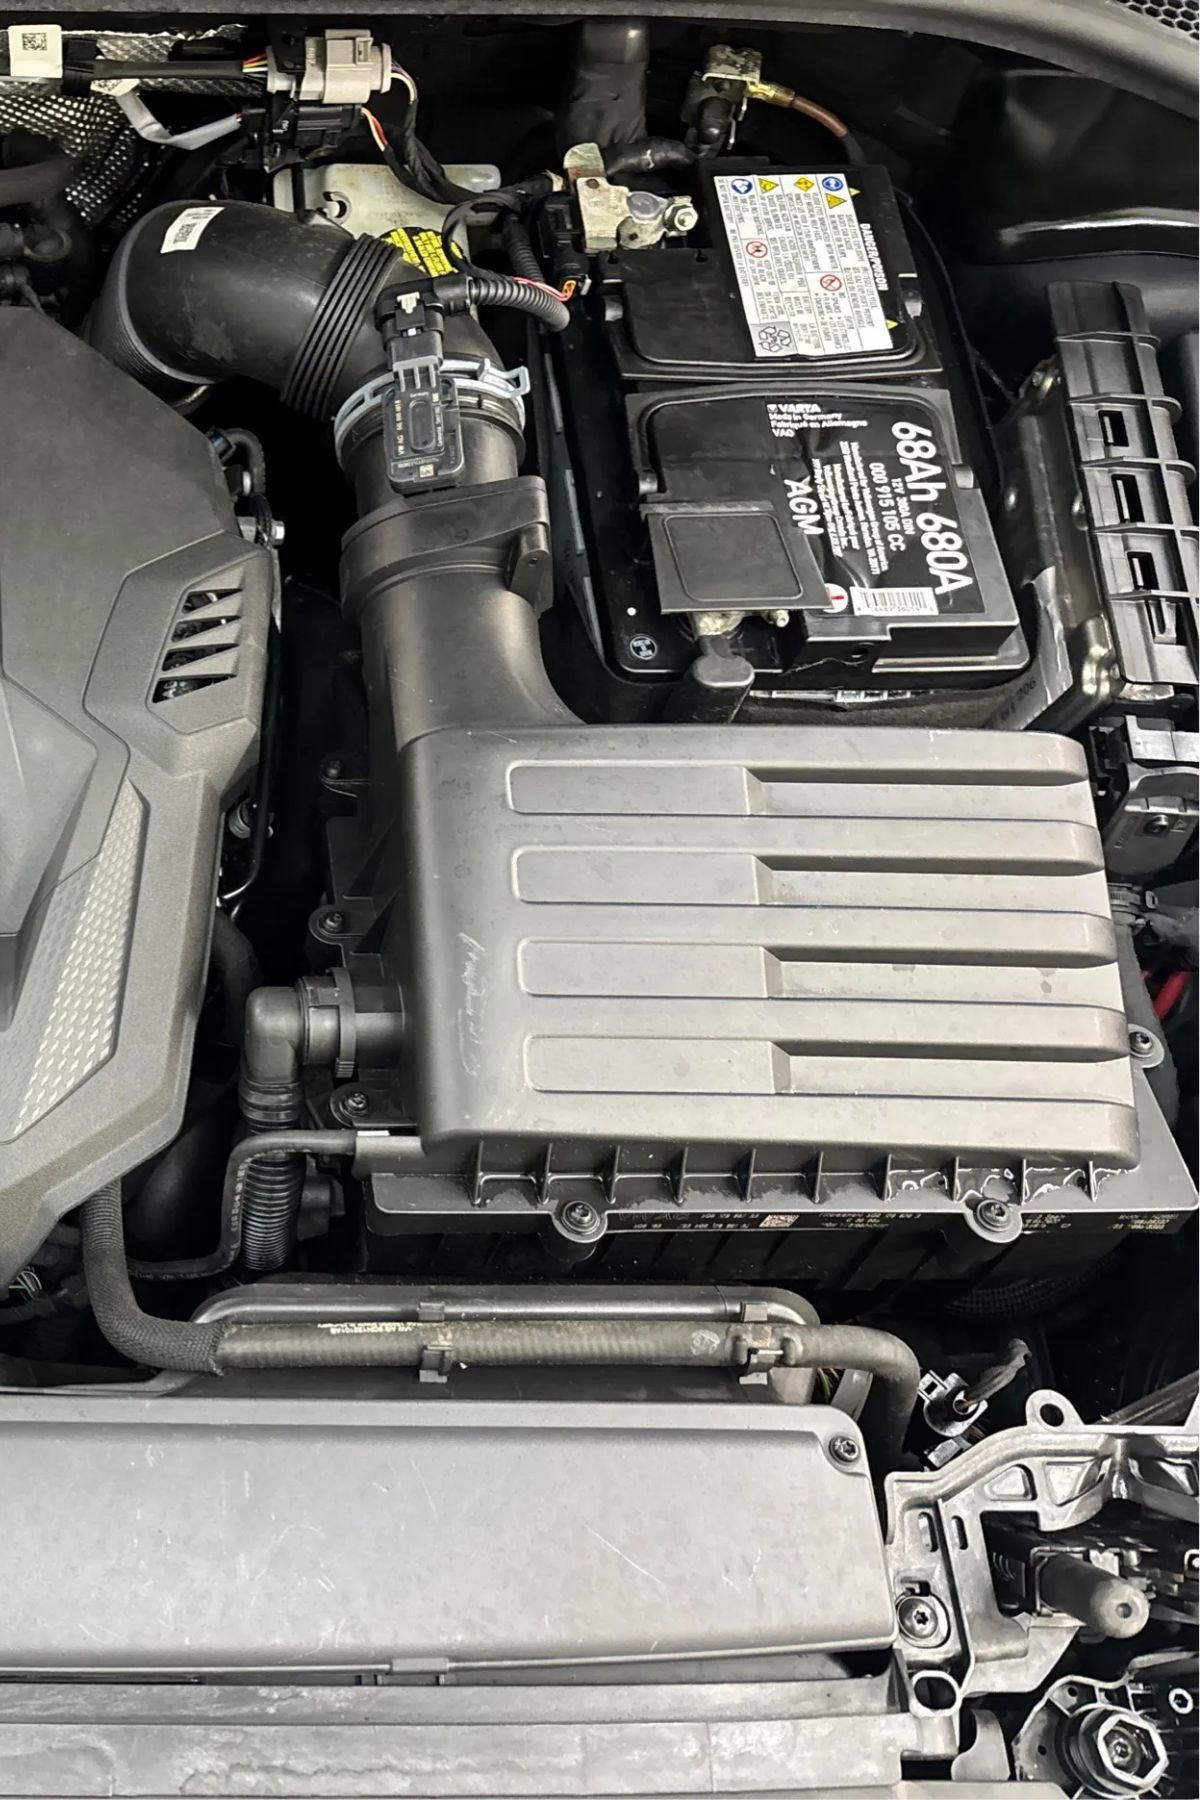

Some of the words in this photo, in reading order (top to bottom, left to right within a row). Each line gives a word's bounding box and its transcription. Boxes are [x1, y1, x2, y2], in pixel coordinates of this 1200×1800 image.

[860, 223, 888, 291] DANGER/POISON
[778, 403, 821, 413] VARTA
[802, 412, 842, 421] Germany
[821, 420, 868, 429] Allemagne
[891, 421, 947, 502] 68Ah
[869, 462, 888, 484] 000
[784, 478, 824, 535] AGM
[875, 485, 895, 507] 915
[891, 478, 905, 494] 12V
[901, 518, 915, 535] DIN
[881, 510, 901, 531] 105
[887, 533, 906, 551] CC
[916, 512, 973, 595] 680A
